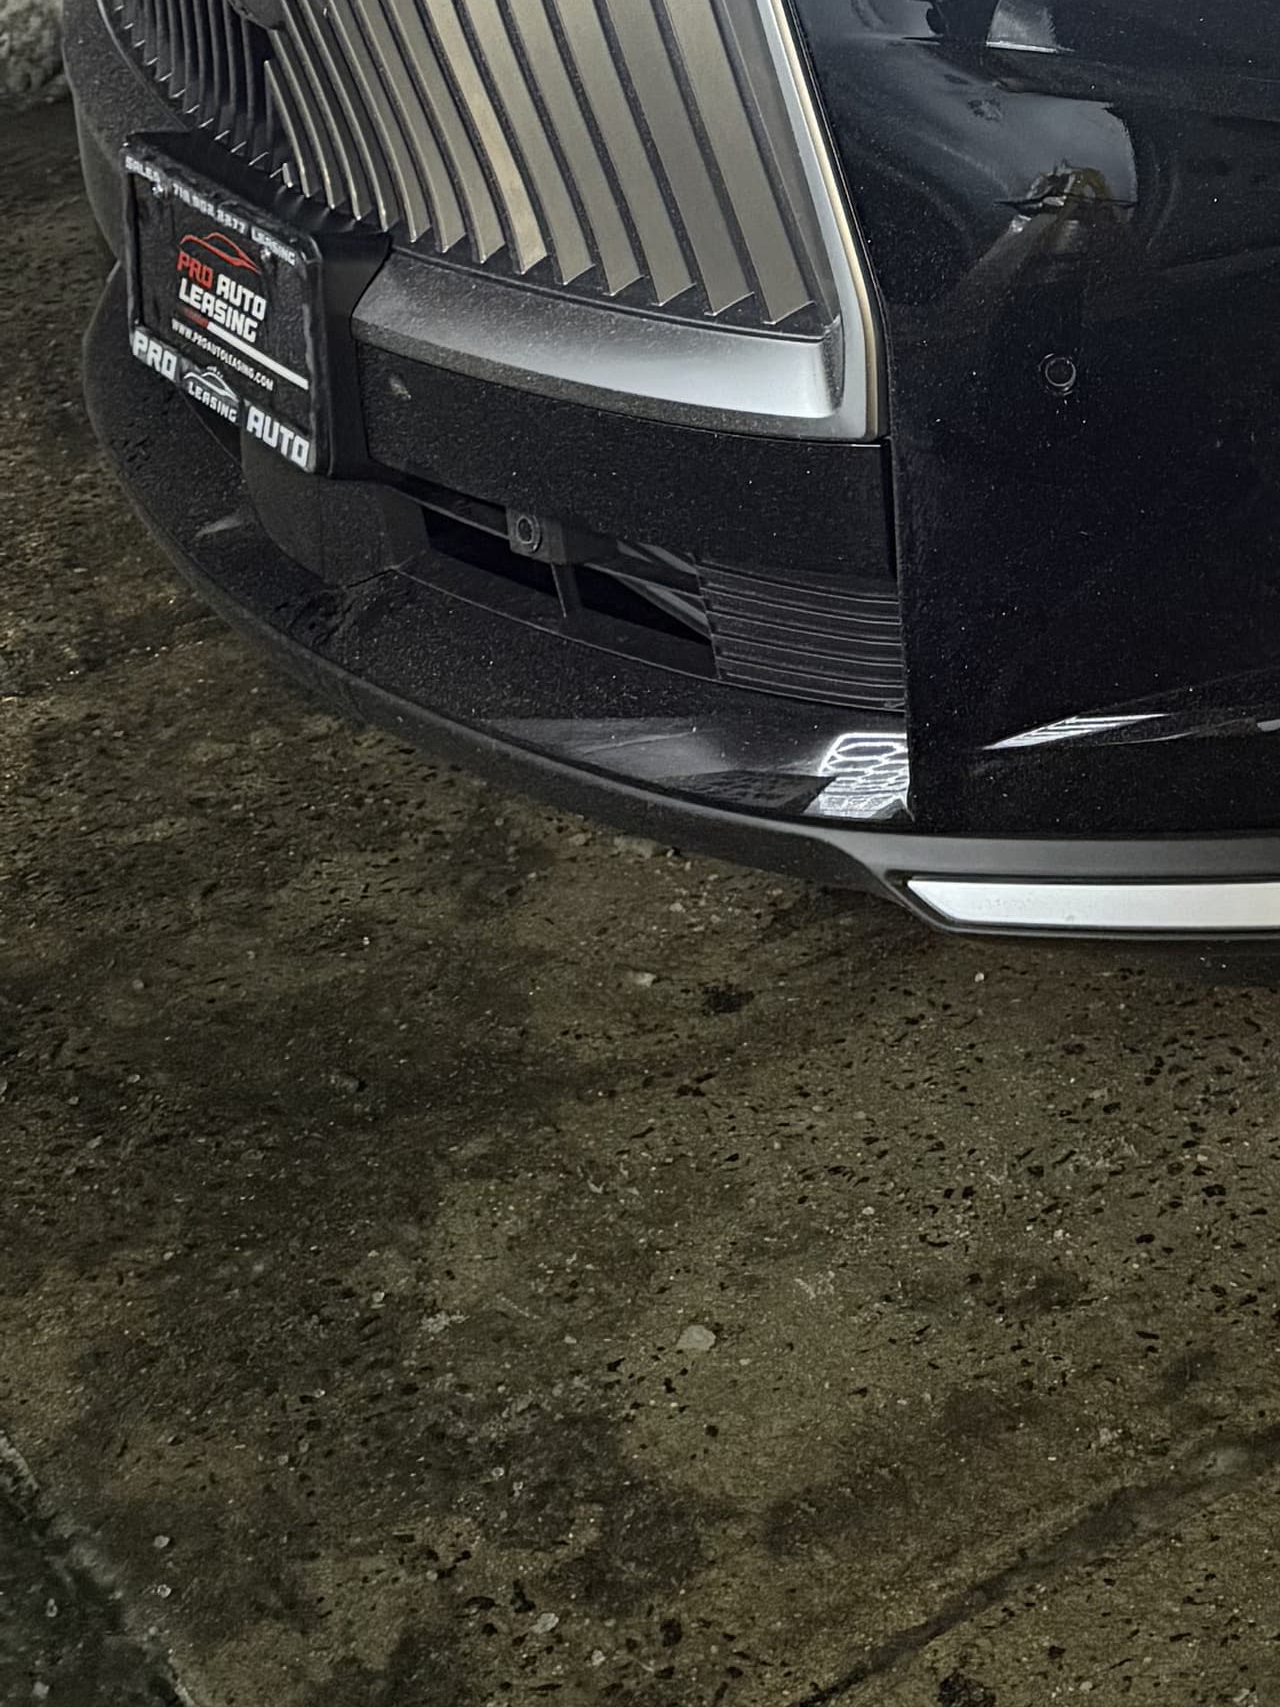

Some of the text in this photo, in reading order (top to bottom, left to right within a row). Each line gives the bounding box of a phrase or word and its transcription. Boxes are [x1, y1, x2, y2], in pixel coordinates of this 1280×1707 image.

[177, 250, 267, 317] PRO AUTO
[178, 277, 259, 343] LEASING
[132, 330, 310, 470] PRO LEASING AUTO
